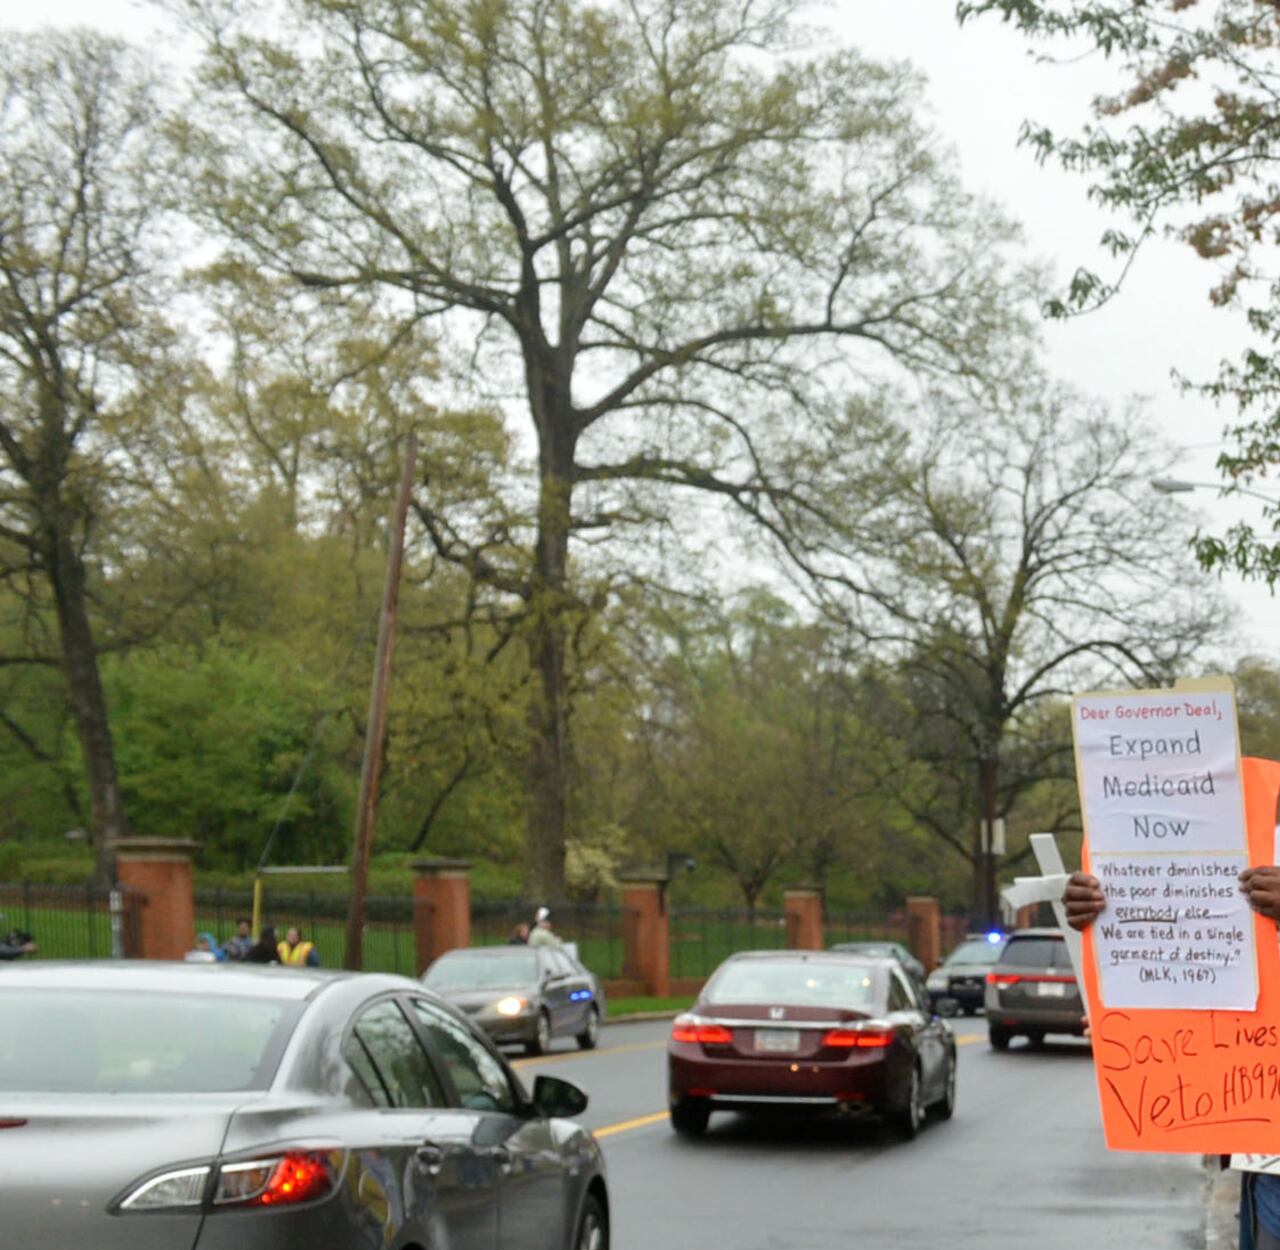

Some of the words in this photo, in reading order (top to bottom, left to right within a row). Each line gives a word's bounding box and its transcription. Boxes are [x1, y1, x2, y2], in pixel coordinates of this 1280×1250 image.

[1080, 706, 1110, 720] Dear
[1115, 704, 1181, 719] Governor
[1184, 700, 1222, 721] Deal,
[1109, 729, 1202, 761] Expand
[1103, 771, 1216, 799] Medicaid
[1133, 815, 1191, 839] Now
[1103, 883, 1127, 898] the
[1129, 885, 1158, 902] poor
[1162, 883, 1234, 898] diminishes
[1115, 905, 1180, 924] everybody
[1101, 924, 1124, 940] We
[1126, 929, 1145, 940] are
[1150, 926, 1175, 941] tied
[1178, 927, 1190, 940] in
[1194, 930, 1203, 940] a
[1206, 925, 1244, 945] single
[1110, 948, 1165, 967] garment
[1169, 946, 1182, 961] of
[1139, 967, 1177, 984] (MLK,
[1182, 968, 1216, 985] 1967)
[1102, 1011, 1198, 1072] Save
[1210, 1010, 1279, 1050] Lives
[1104, 1074, 1213, 1138] Veto
